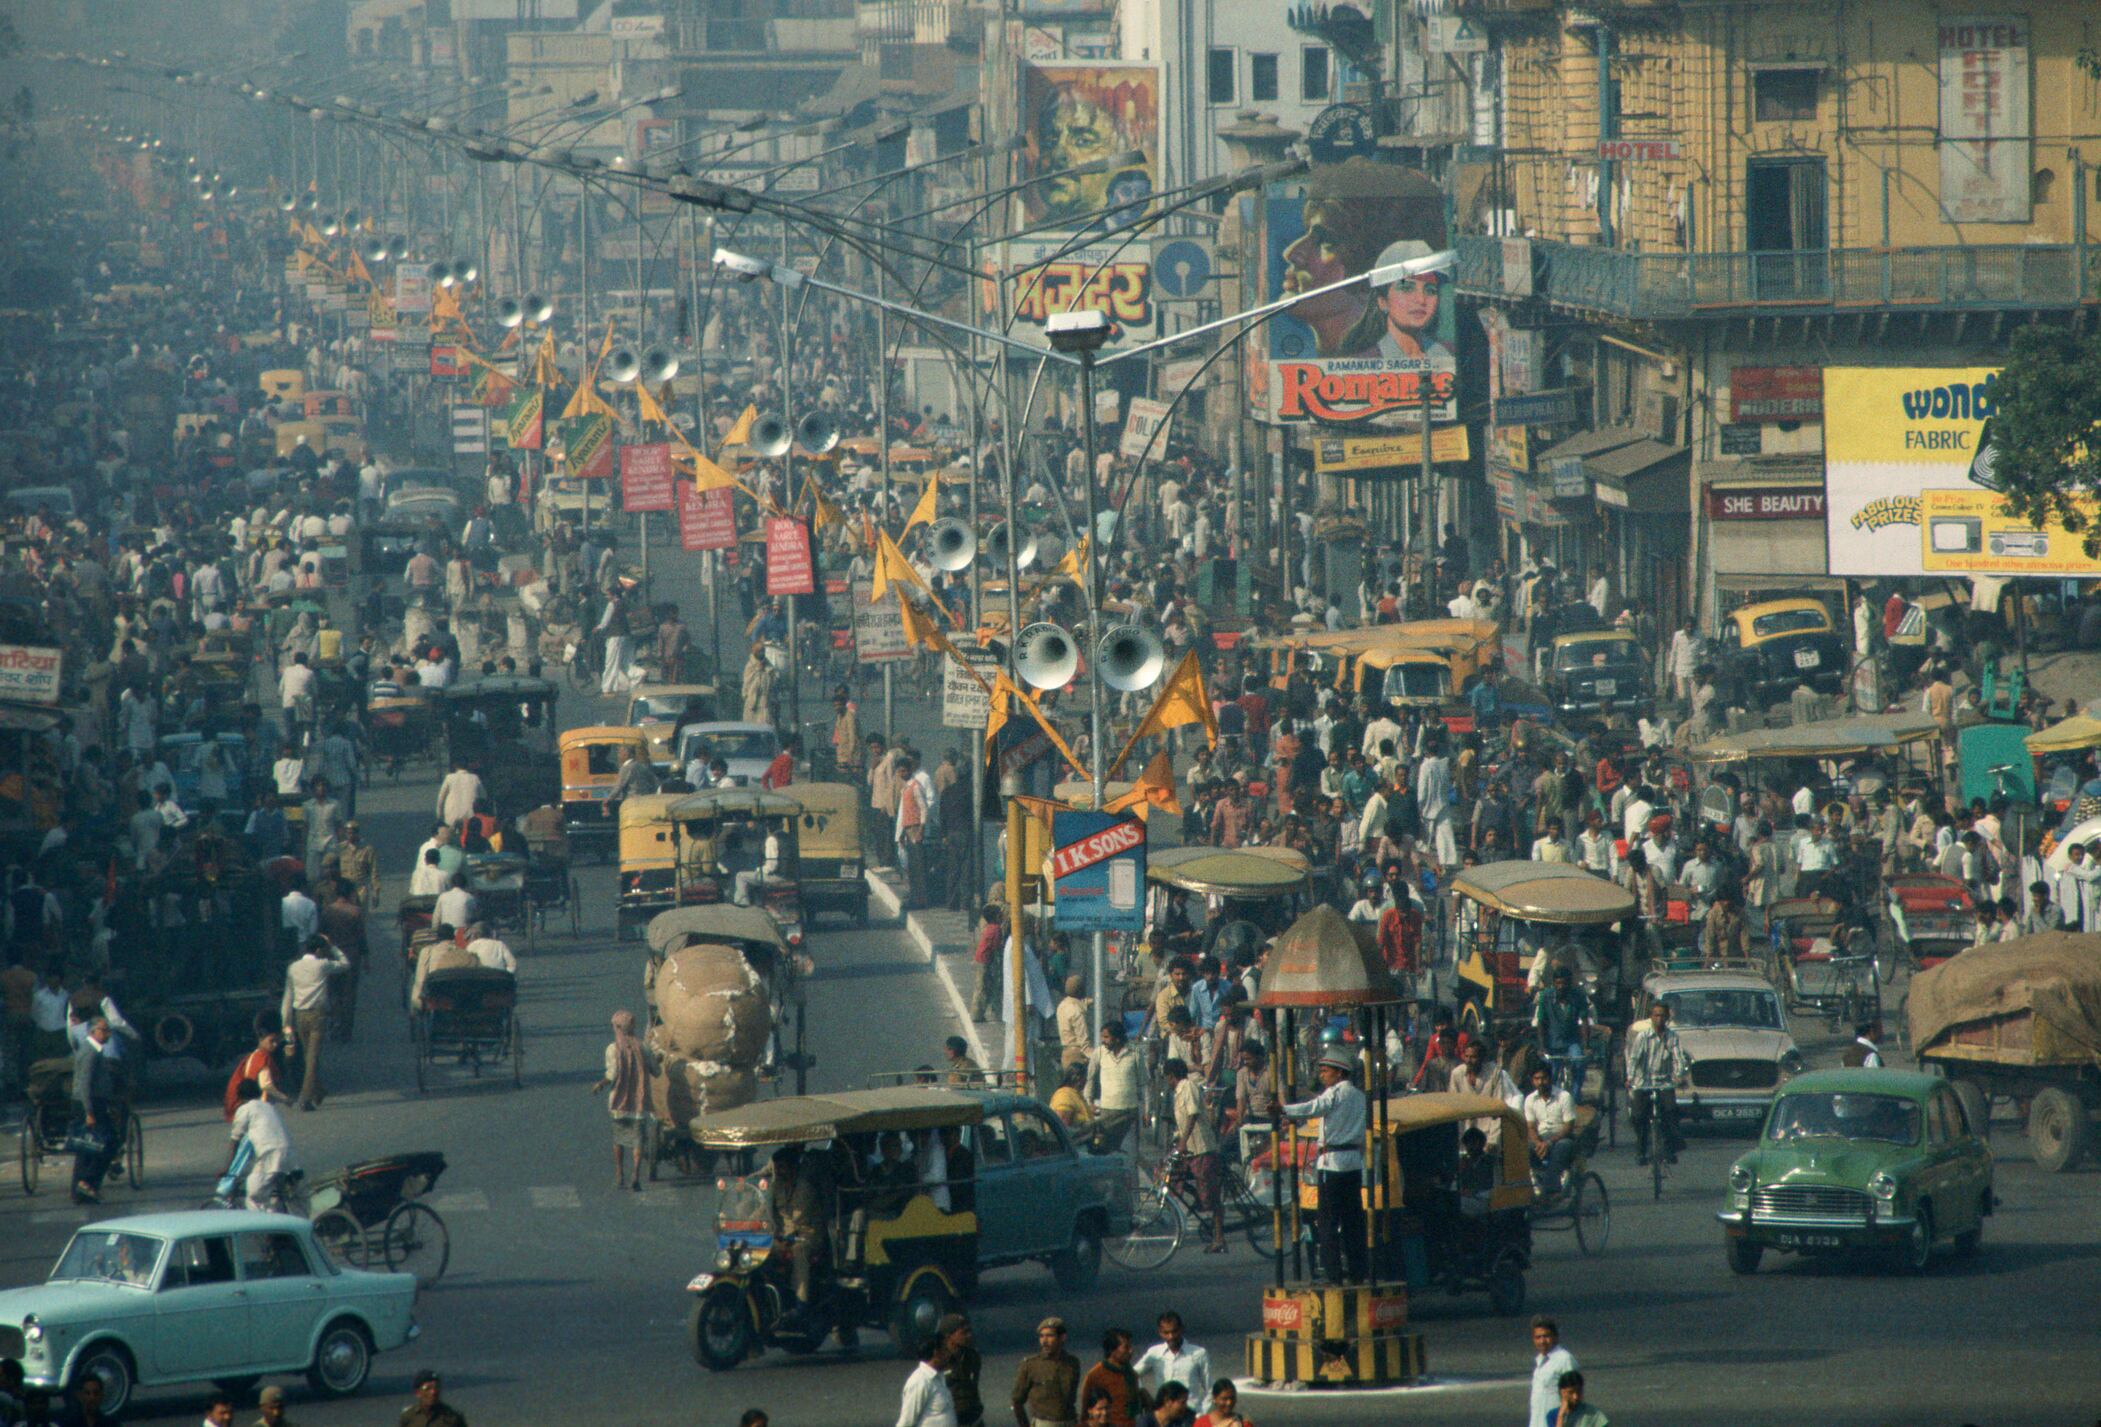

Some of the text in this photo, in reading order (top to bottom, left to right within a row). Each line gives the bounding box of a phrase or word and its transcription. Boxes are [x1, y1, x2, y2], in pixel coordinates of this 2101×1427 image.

[1939, 26, 2028, 48] HOTEL
[1600, 142, 1680, 159] HOTEL
[1328, 359, 1384, 372] RAMANAND
[1905, 430, 1970, 449] FABRIC
[1724, 495, 1822, 513] SHE BEAUTY
[1851, 496, 1922, 529] FABULOUS
[1866, 508, 1921, 532] PRIZES
